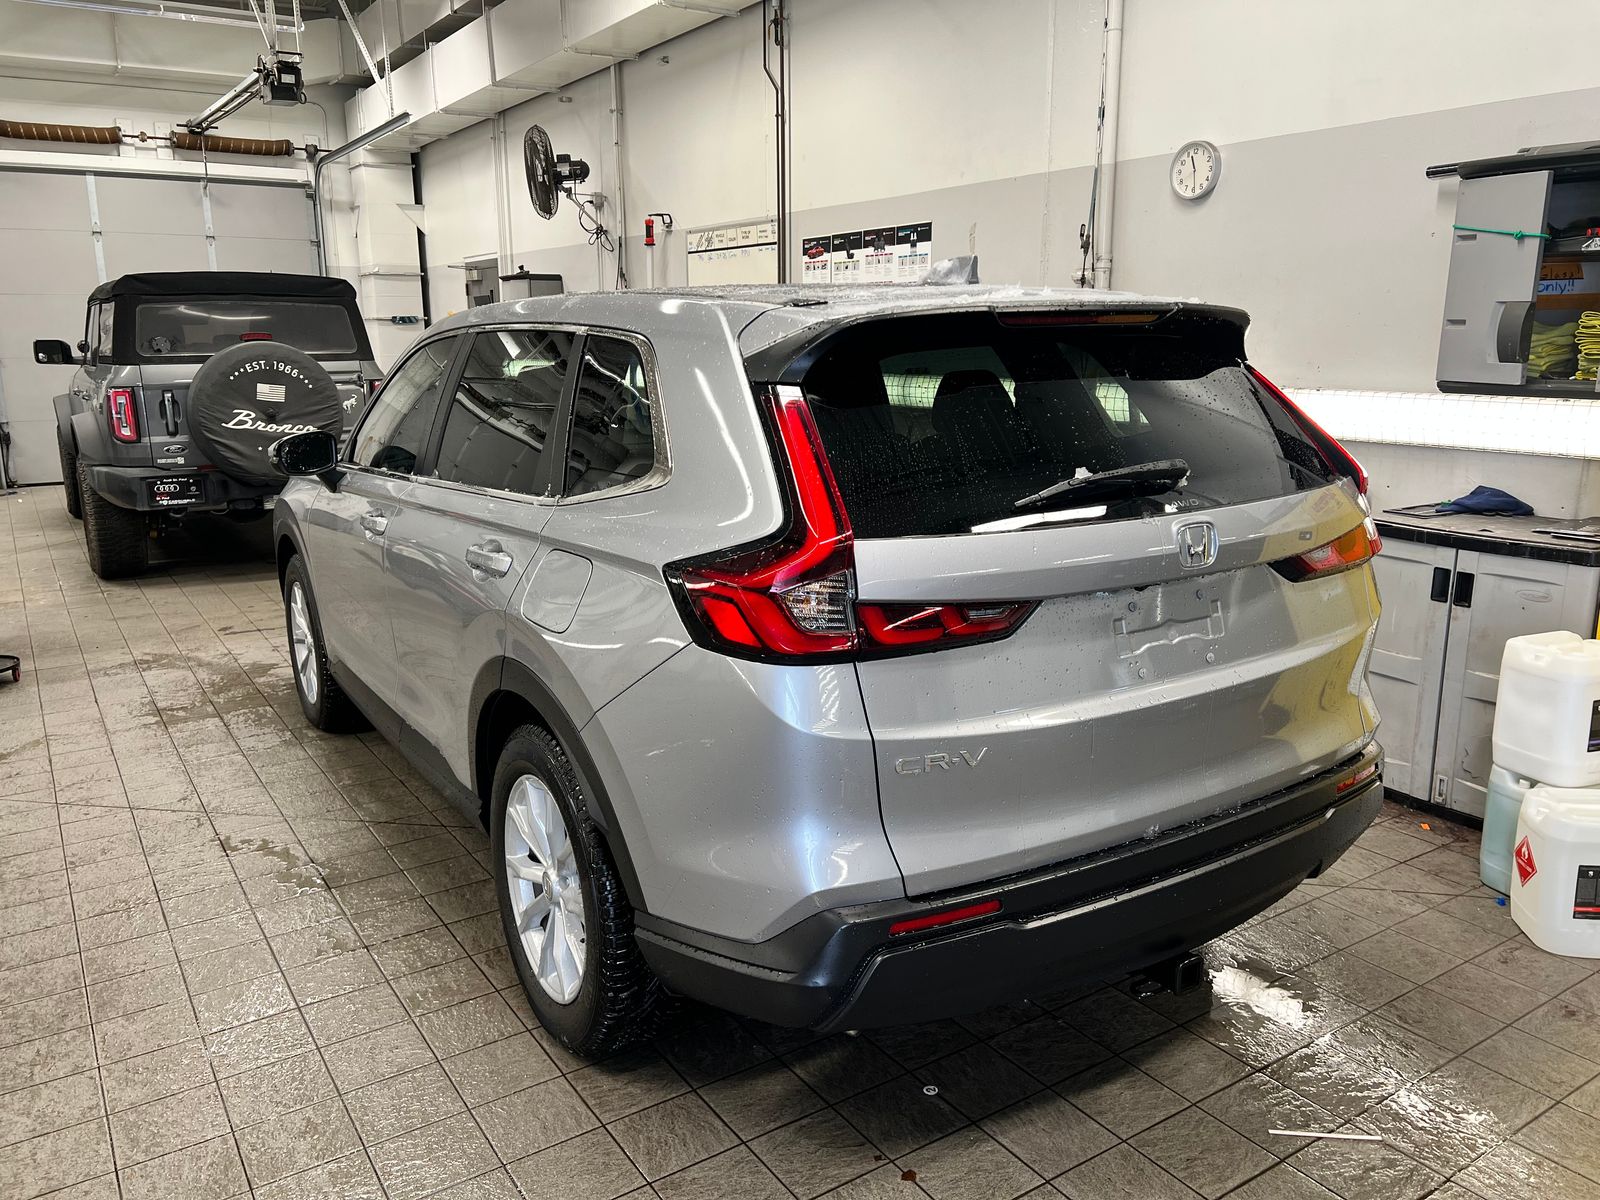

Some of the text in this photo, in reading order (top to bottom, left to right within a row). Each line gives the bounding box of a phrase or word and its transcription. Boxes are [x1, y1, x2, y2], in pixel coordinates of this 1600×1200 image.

[244, 360, 299, 377] EST. 1966
[221, 409, 321, 434] Bronco
[894, 747, 988, 775] CR-V
